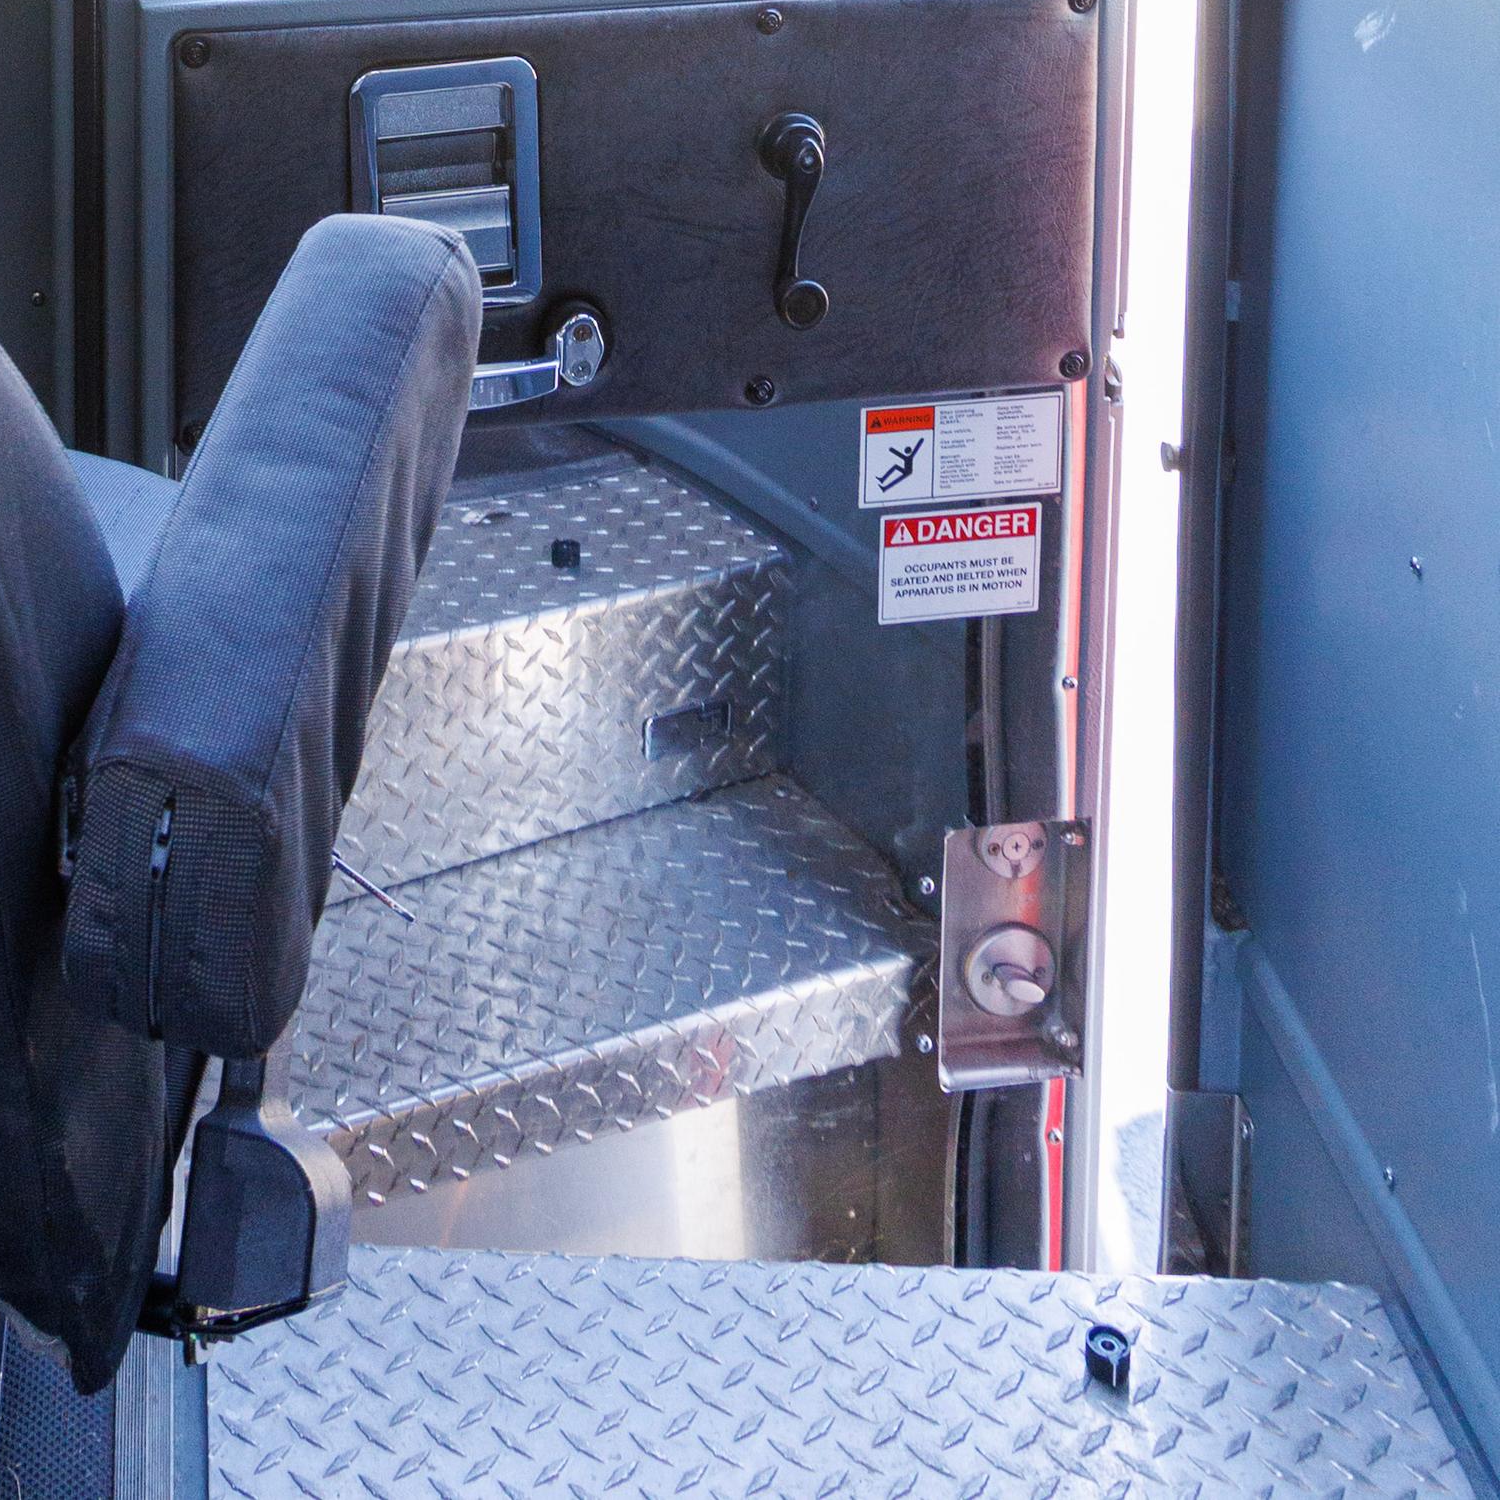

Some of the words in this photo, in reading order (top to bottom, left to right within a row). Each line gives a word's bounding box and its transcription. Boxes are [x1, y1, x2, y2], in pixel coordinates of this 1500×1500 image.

[884, 414, 931, 425] WARNING
[917, 512, 1030, 543] DANGER
[904, 559, 967, 574] OCCUPANTS
[969, 557, 998, 569] MUST
[1001, 556, 1014, 565] BE
[890, 575, 930, 587] SEATED
[932, 573, 954, 583] AND
[956, 570, 995, 581] BELTED
[997, 568, 1028, 578] WHEN
[895, 585, 954, 599] APPARATUS
[957, 584, 966, 593] IS
[969, 583, 979, 592] IN
[982, 580, 1023, 592] MOTION
